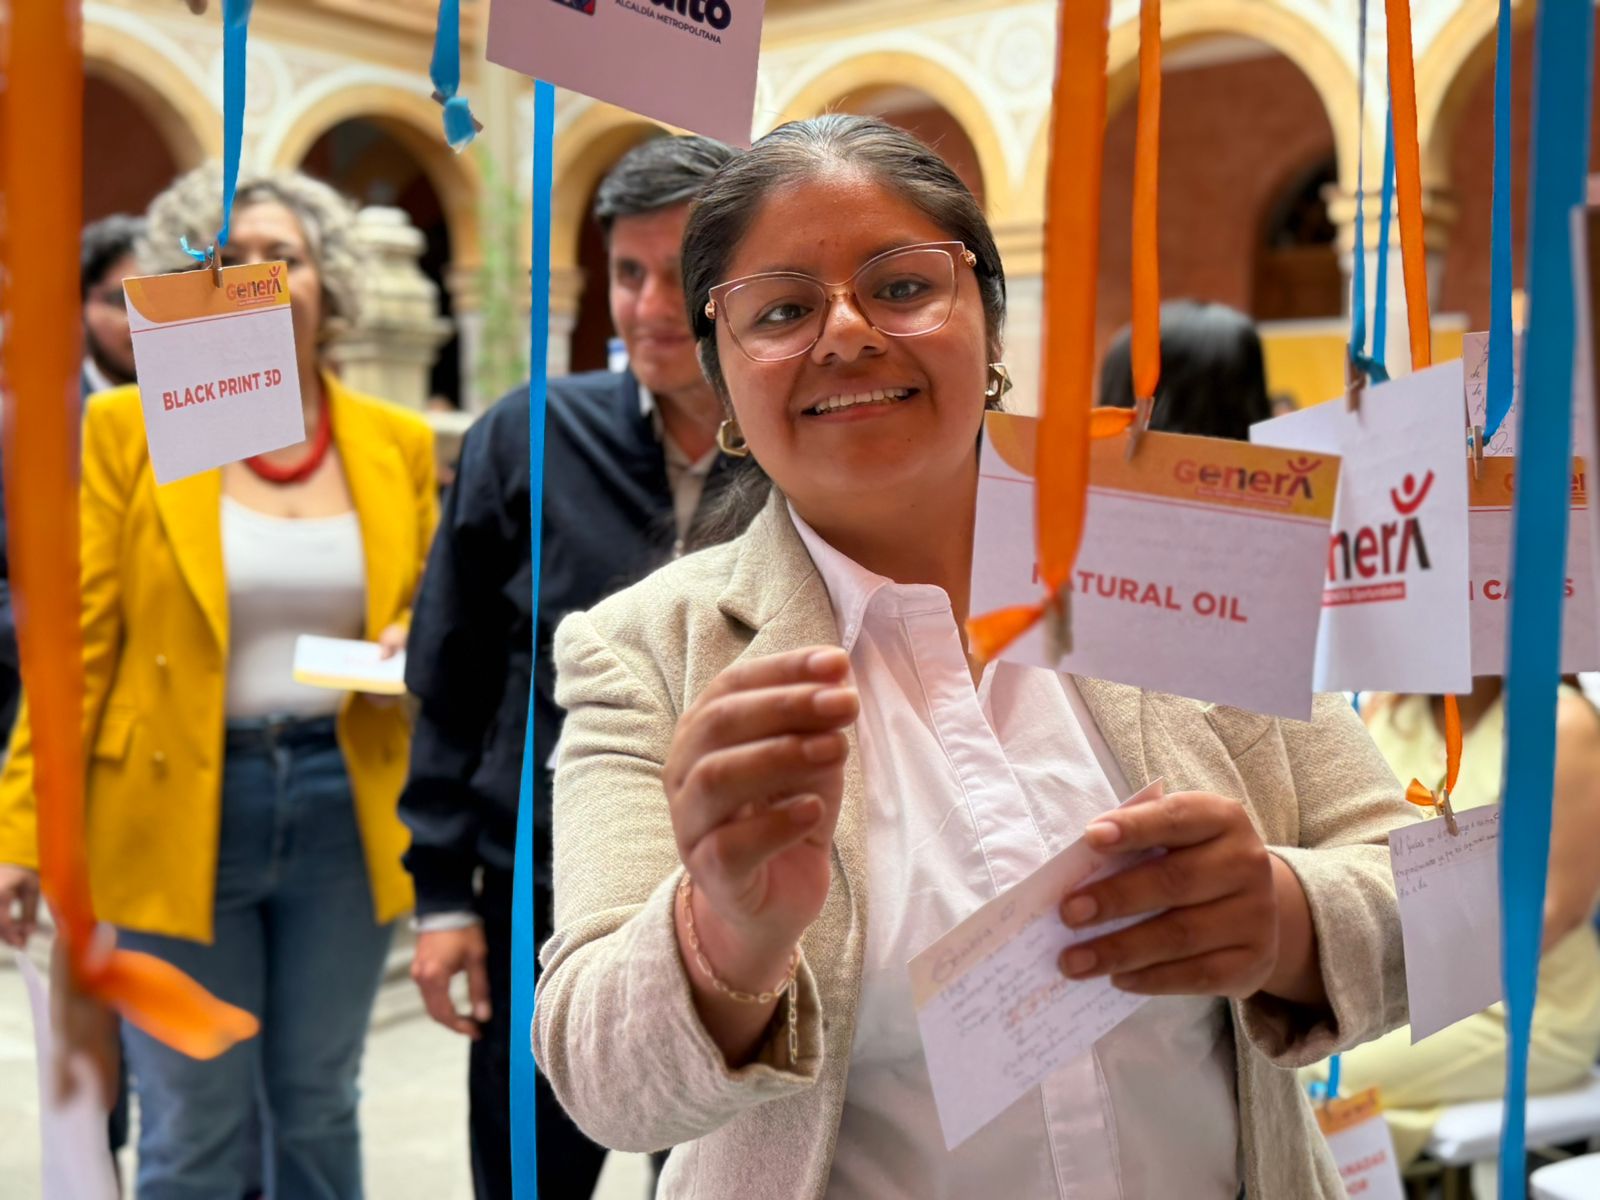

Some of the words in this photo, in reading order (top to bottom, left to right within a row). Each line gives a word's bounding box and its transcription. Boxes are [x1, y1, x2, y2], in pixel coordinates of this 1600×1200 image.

[615, 0, 655, 19] ALCALDÍA
[657, 13, 721, 44] METROPOLITANA
[162, 382, 216, 411] BLACK
[218, 372, 261, 398] PRINT
[264, 368, 282, 387] 3D
[1192, 591, 1248, 623] OIL
